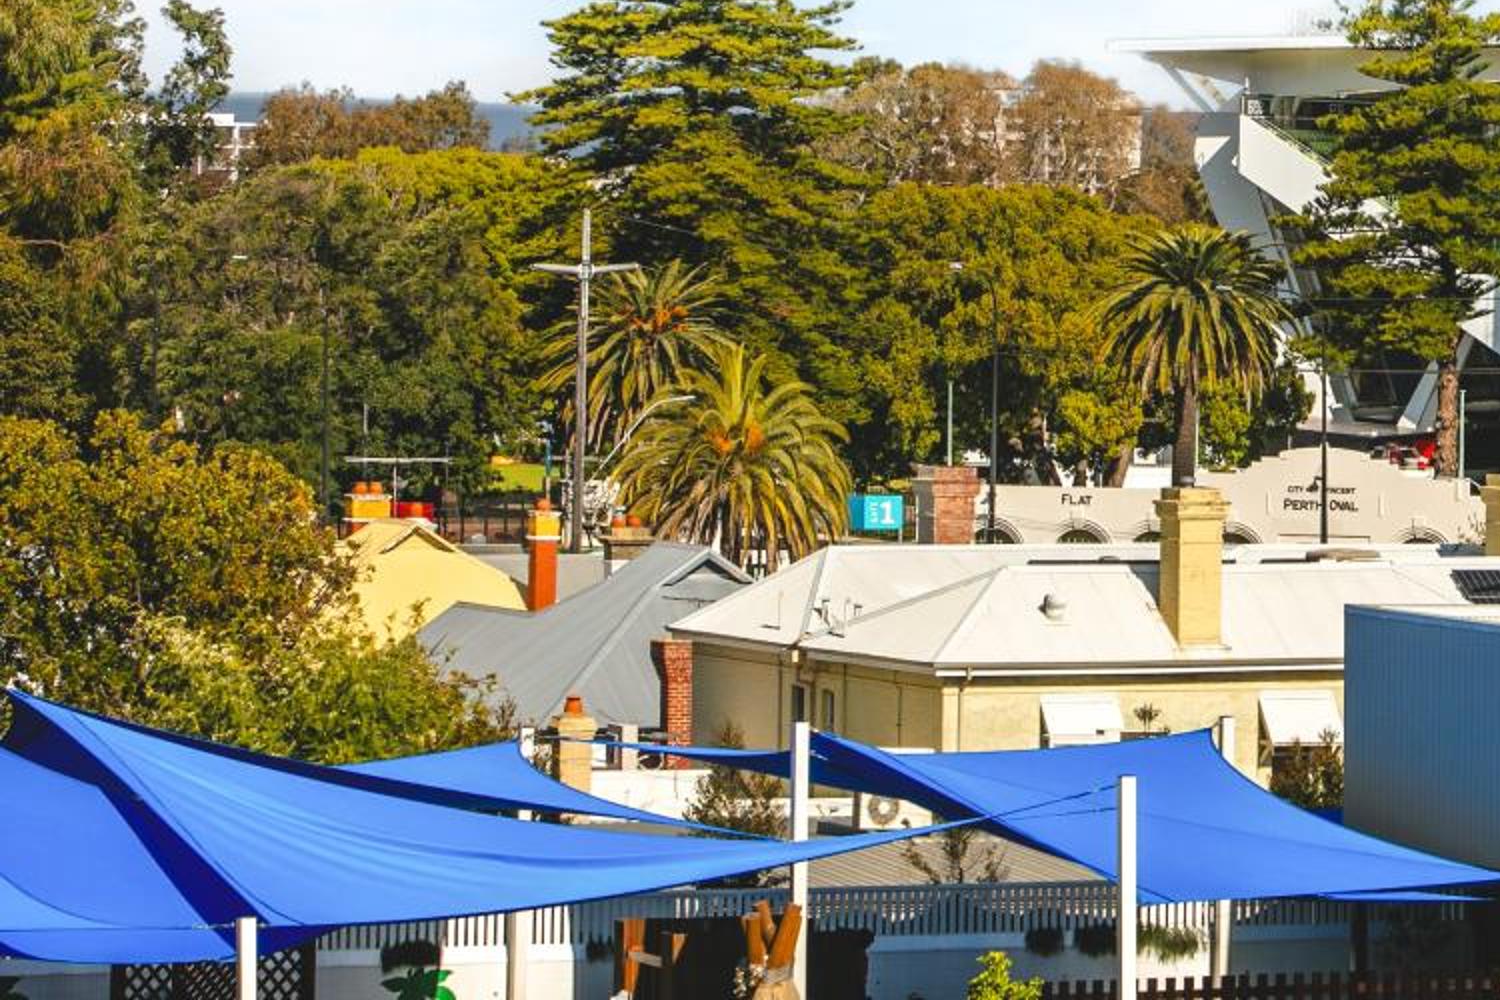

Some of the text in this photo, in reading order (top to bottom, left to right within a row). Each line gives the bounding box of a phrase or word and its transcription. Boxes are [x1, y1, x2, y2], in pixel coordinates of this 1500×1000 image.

[1061, 493, 1093, 505] FLAT
[1283, 497, 1359, 512] PERTH OVAL
[879, 501, 896, 524] 1
